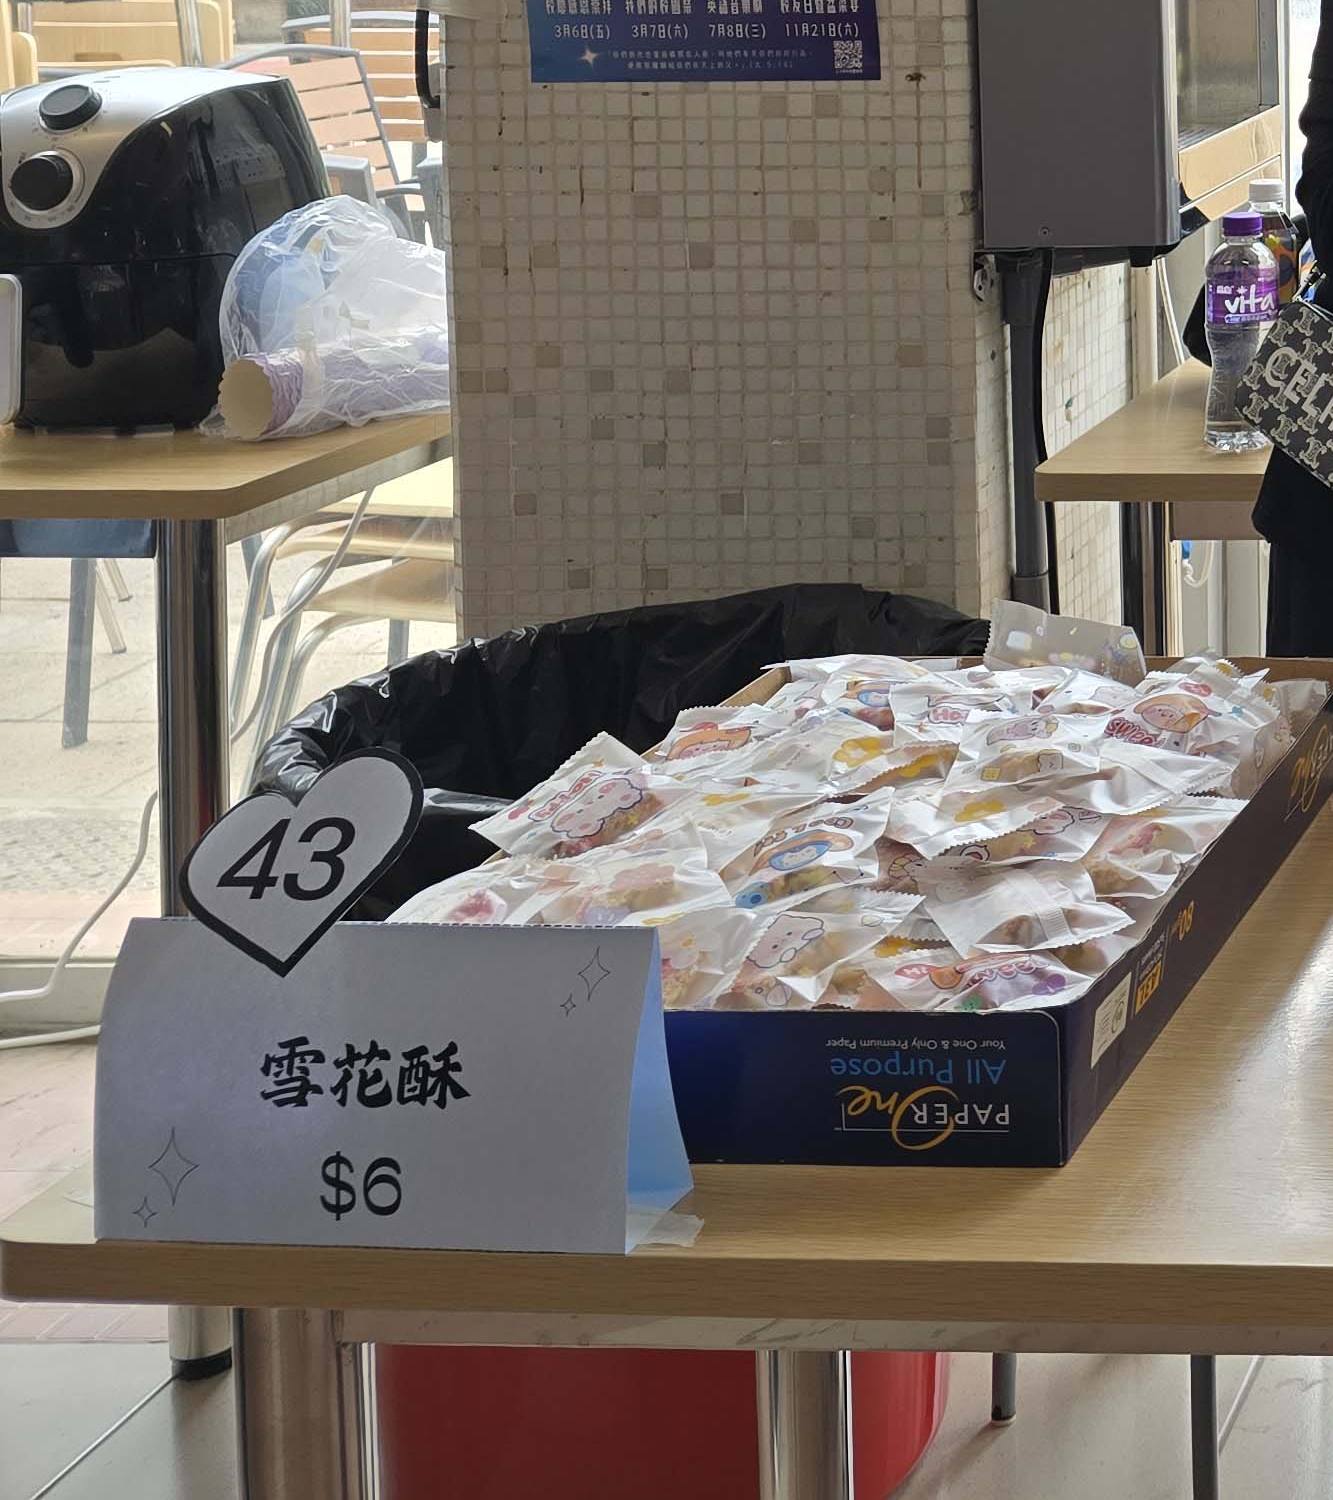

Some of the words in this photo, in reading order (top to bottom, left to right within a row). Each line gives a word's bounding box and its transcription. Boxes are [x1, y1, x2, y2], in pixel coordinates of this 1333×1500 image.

[554, 23, 611, 40] 3月6日(五)
[631, 23, 689, 39] 3月7日(六)
[708, 23, 766, 39] 7月8日(三)
[785, 22, 859, 39] 11月21日(六)
[1225, 284, 1274, 313] vita
[216, 817, 356, 901] 43
[825, 1037, 857, 1051] Paper
[860, 1038, 908, 1051] Premium
[911, 1037, 938, 1051] Only
[941, 1039, 950, 1050] &
[953, 1038, 977, 1051] One
[980, 1038, 1006, 1051] Your
[259, 1035, 472, 1110] 雪花酥
[830, 1052, 953, 1084] Purpose
[966, 1059, 1006, 1085] All
[835, 1085, 959, 1151] One
[911, 1103, 1010, 1125] PAPER
[320, 1151, 402, 1221] $6
